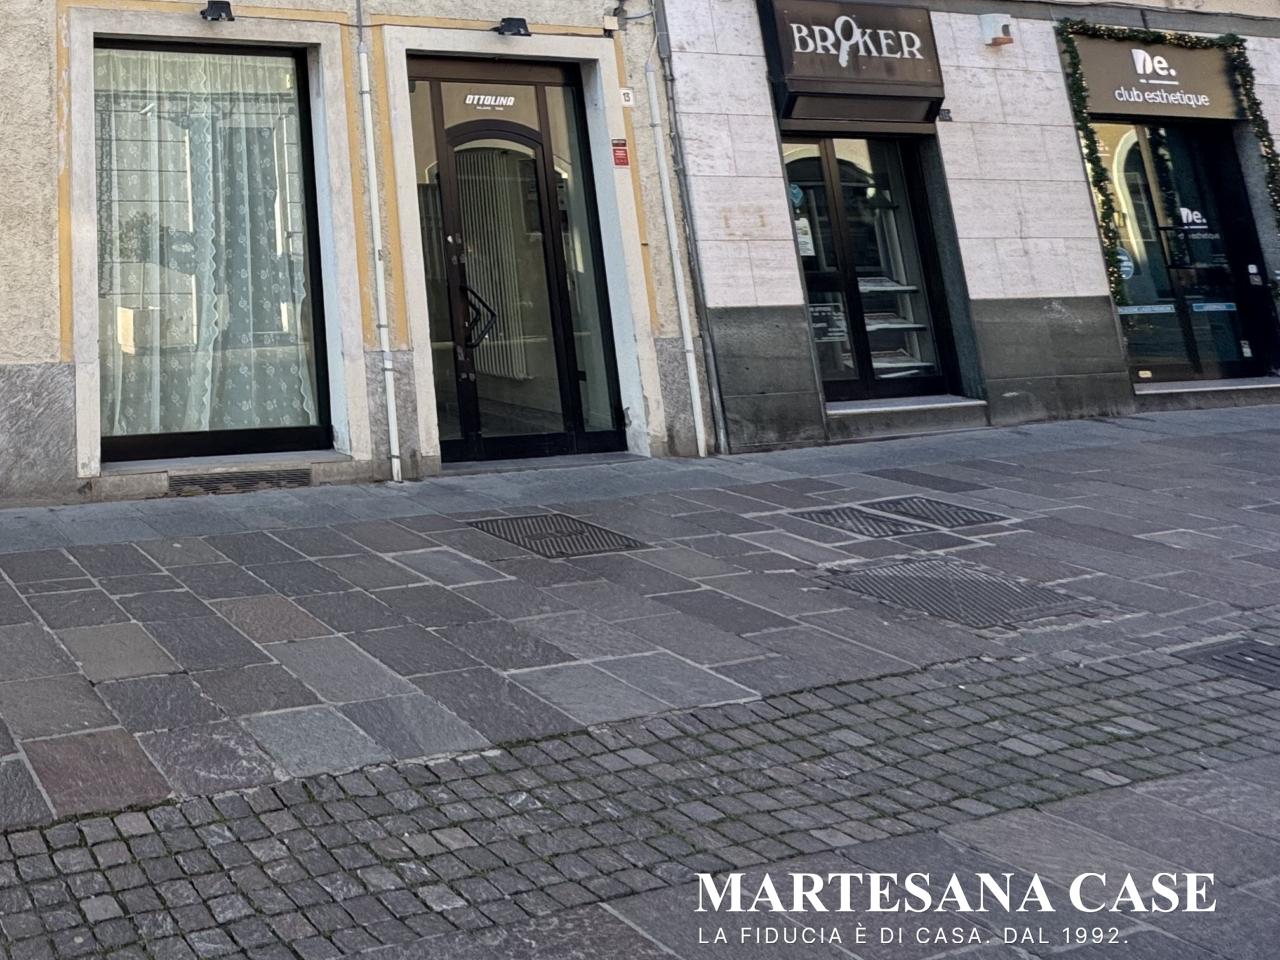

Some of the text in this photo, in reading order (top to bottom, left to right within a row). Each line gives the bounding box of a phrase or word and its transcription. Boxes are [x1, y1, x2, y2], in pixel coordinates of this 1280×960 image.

[790, 15, 924, 67] BROKER
[465, 94, 515, 106] OTTOLINA
[1114, 85, 1211, 108] club esthetique
